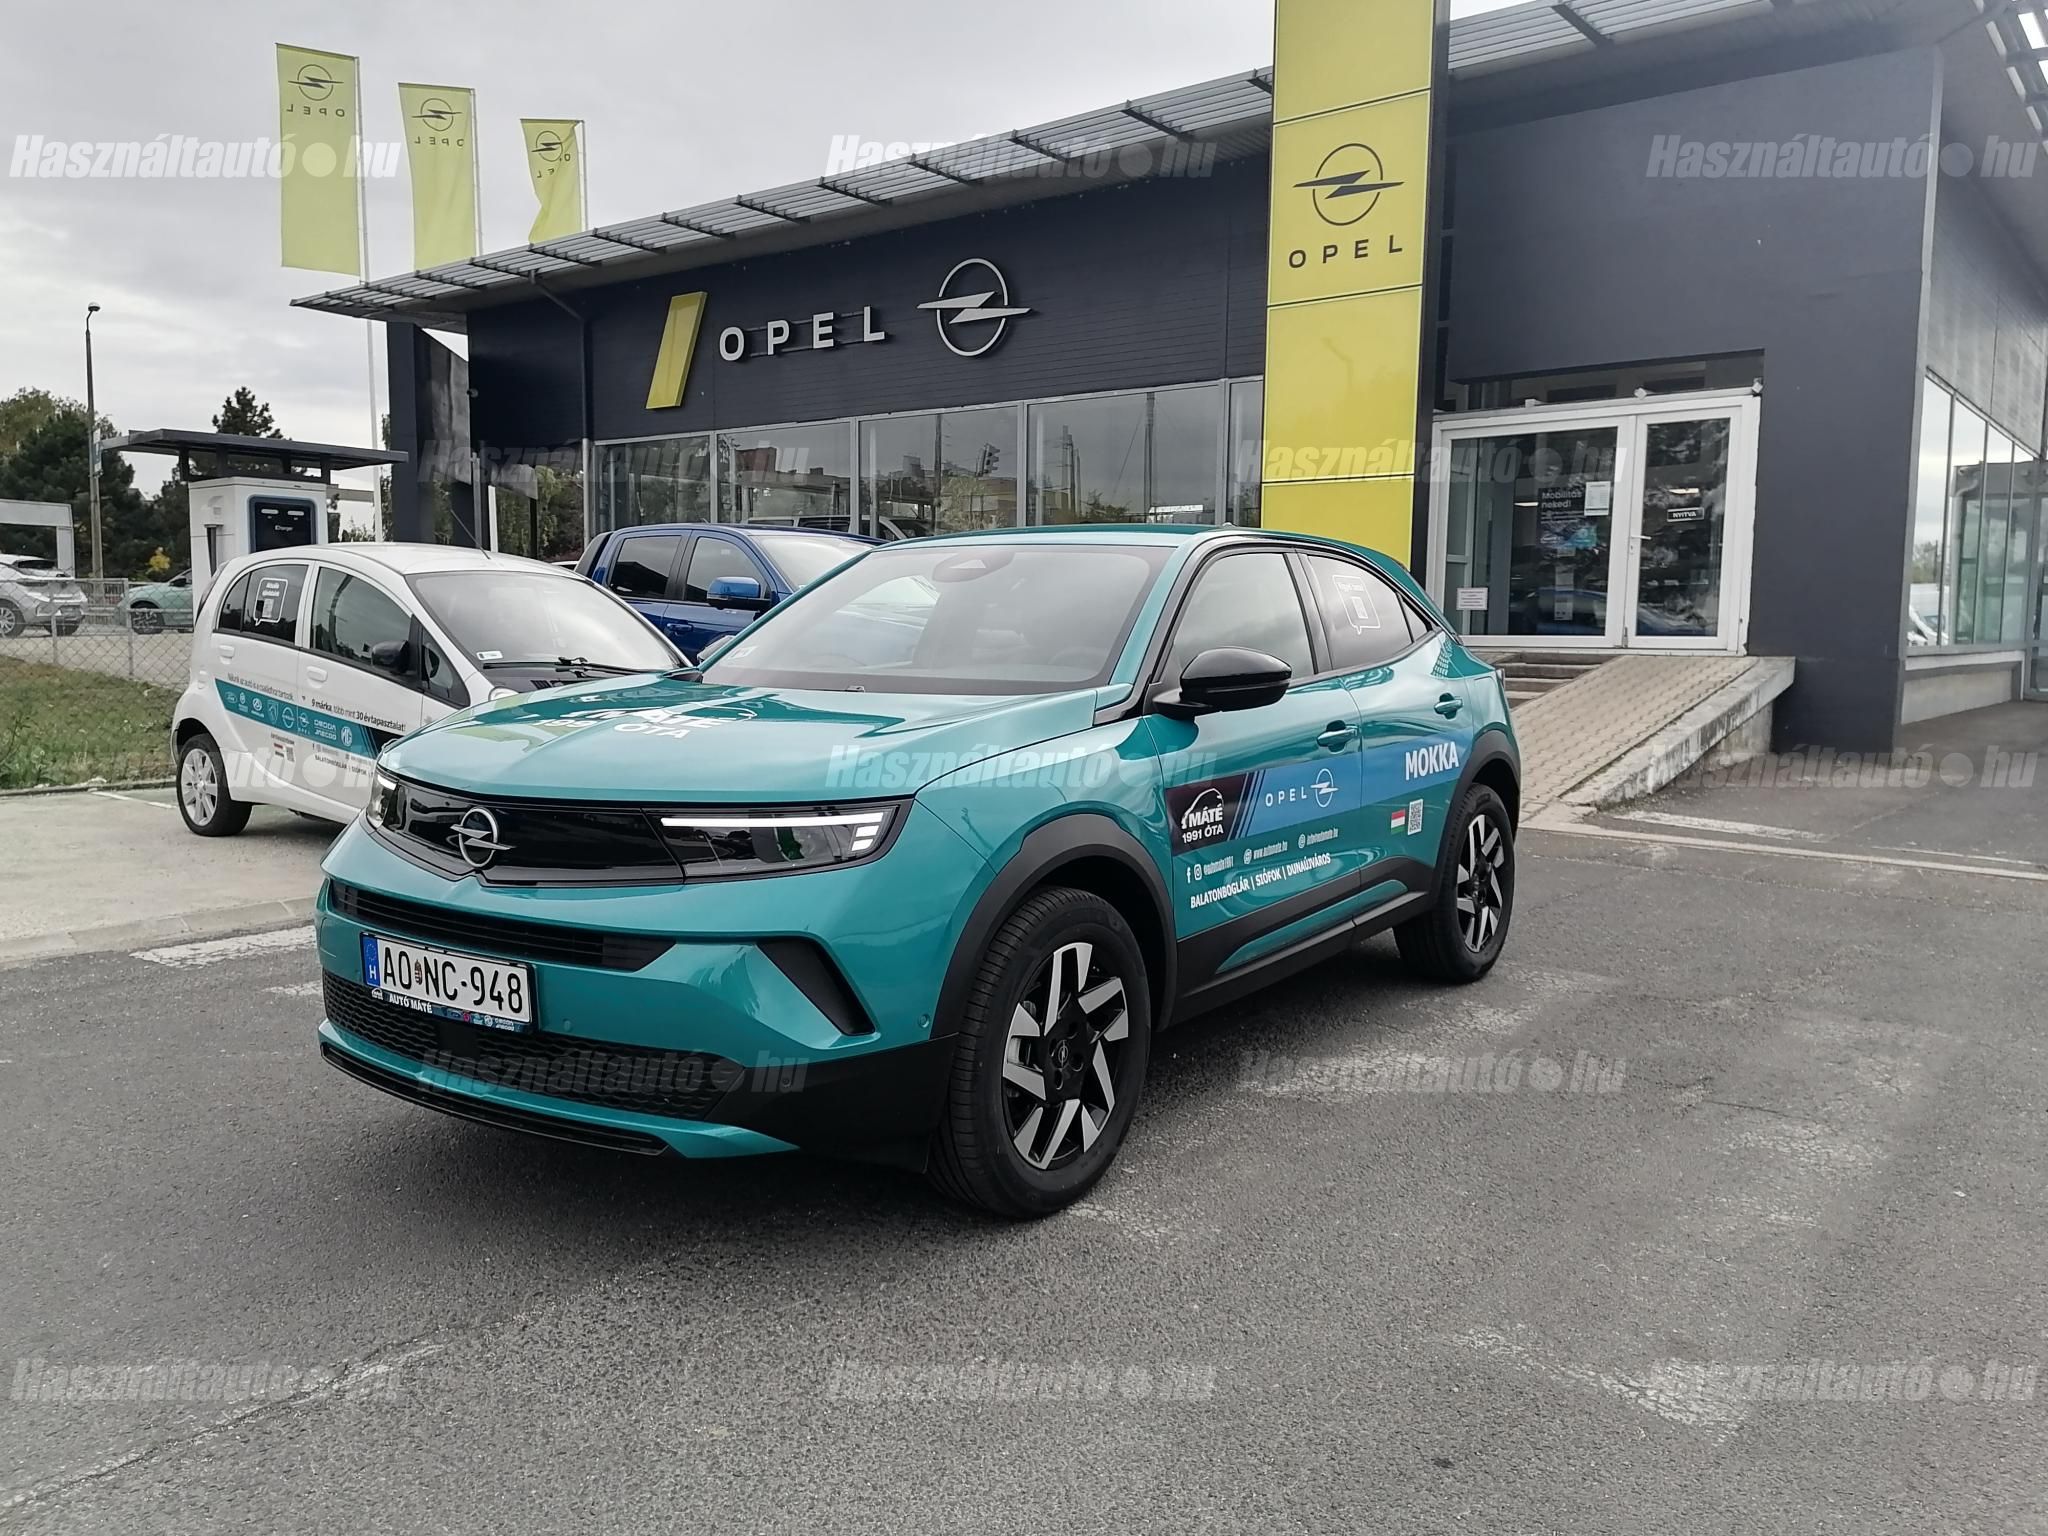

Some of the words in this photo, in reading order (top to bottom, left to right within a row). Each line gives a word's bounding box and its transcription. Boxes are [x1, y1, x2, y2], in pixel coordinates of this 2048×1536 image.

[1288, 234, 1403, 269] OPEL
[718, 305, 886, 362] OPEL
[1405, 741, 1459, 780] MOKKA
[1265, 786, 1307, 807] OPEL
[1188, 804, 1223, 828] MÁTÉ
[1182, 830, 1203, 844] 1991
[1204, 824, 1224, 838] ÓTA
[1190, 875, 1250, 909] BALATONBOGLÁR
[1255, 865, 1282, 887] SIÓFOK
[1287, 852, 1331, 877] DUNAÚJVÁROS
[389, 992, 410, 1008] AUTÓ
[410, 999, 433, 1014] MÁTÉ
